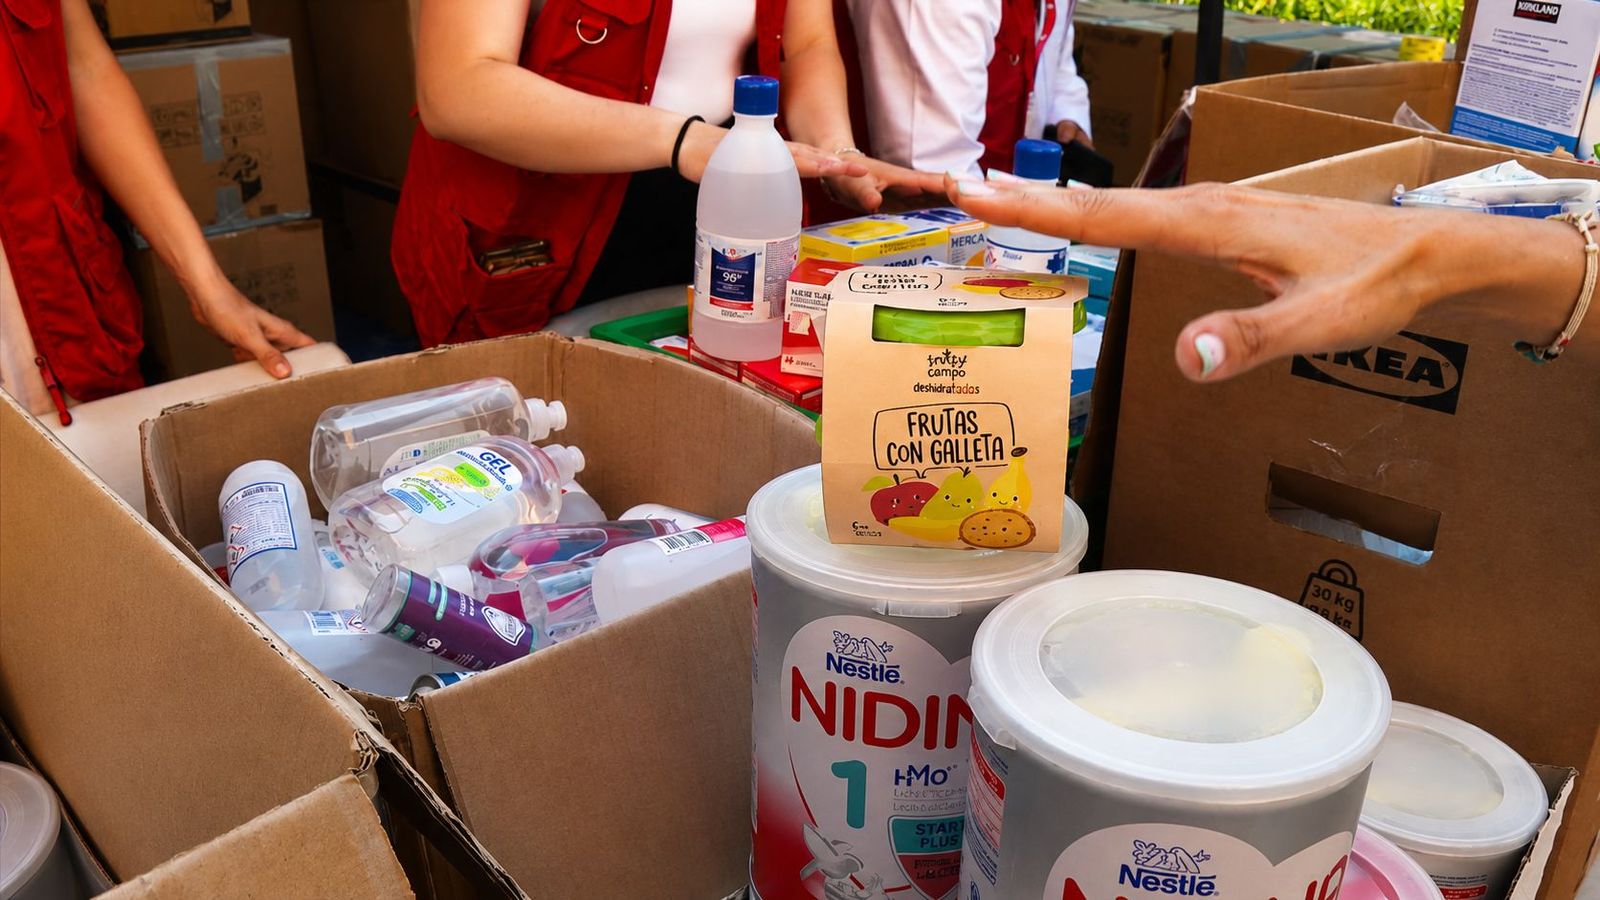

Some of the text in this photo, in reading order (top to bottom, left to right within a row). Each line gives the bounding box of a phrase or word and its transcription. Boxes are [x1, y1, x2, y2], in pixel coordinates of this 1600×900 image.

[1517, 0, 1559, 16] KIRKLAND
[913, 382, 980, 395] deshidratados
[927, 368, 966, 381] campo
[907, 407, 979, 437] FRUTAS
[479, 451, 512, 476] GEL
[886, 433, 1004, 466] CON GALLETA
[1311, 584, 1332, 601] 30
[1334, 591, 1354, 613] kg
[826, 652, 901, 684] Nestlé
[831, 759, 867, 829] 1
[920, 835, 958, 848] PLUS
[1119, 863, 1217, 897] Nestlé
